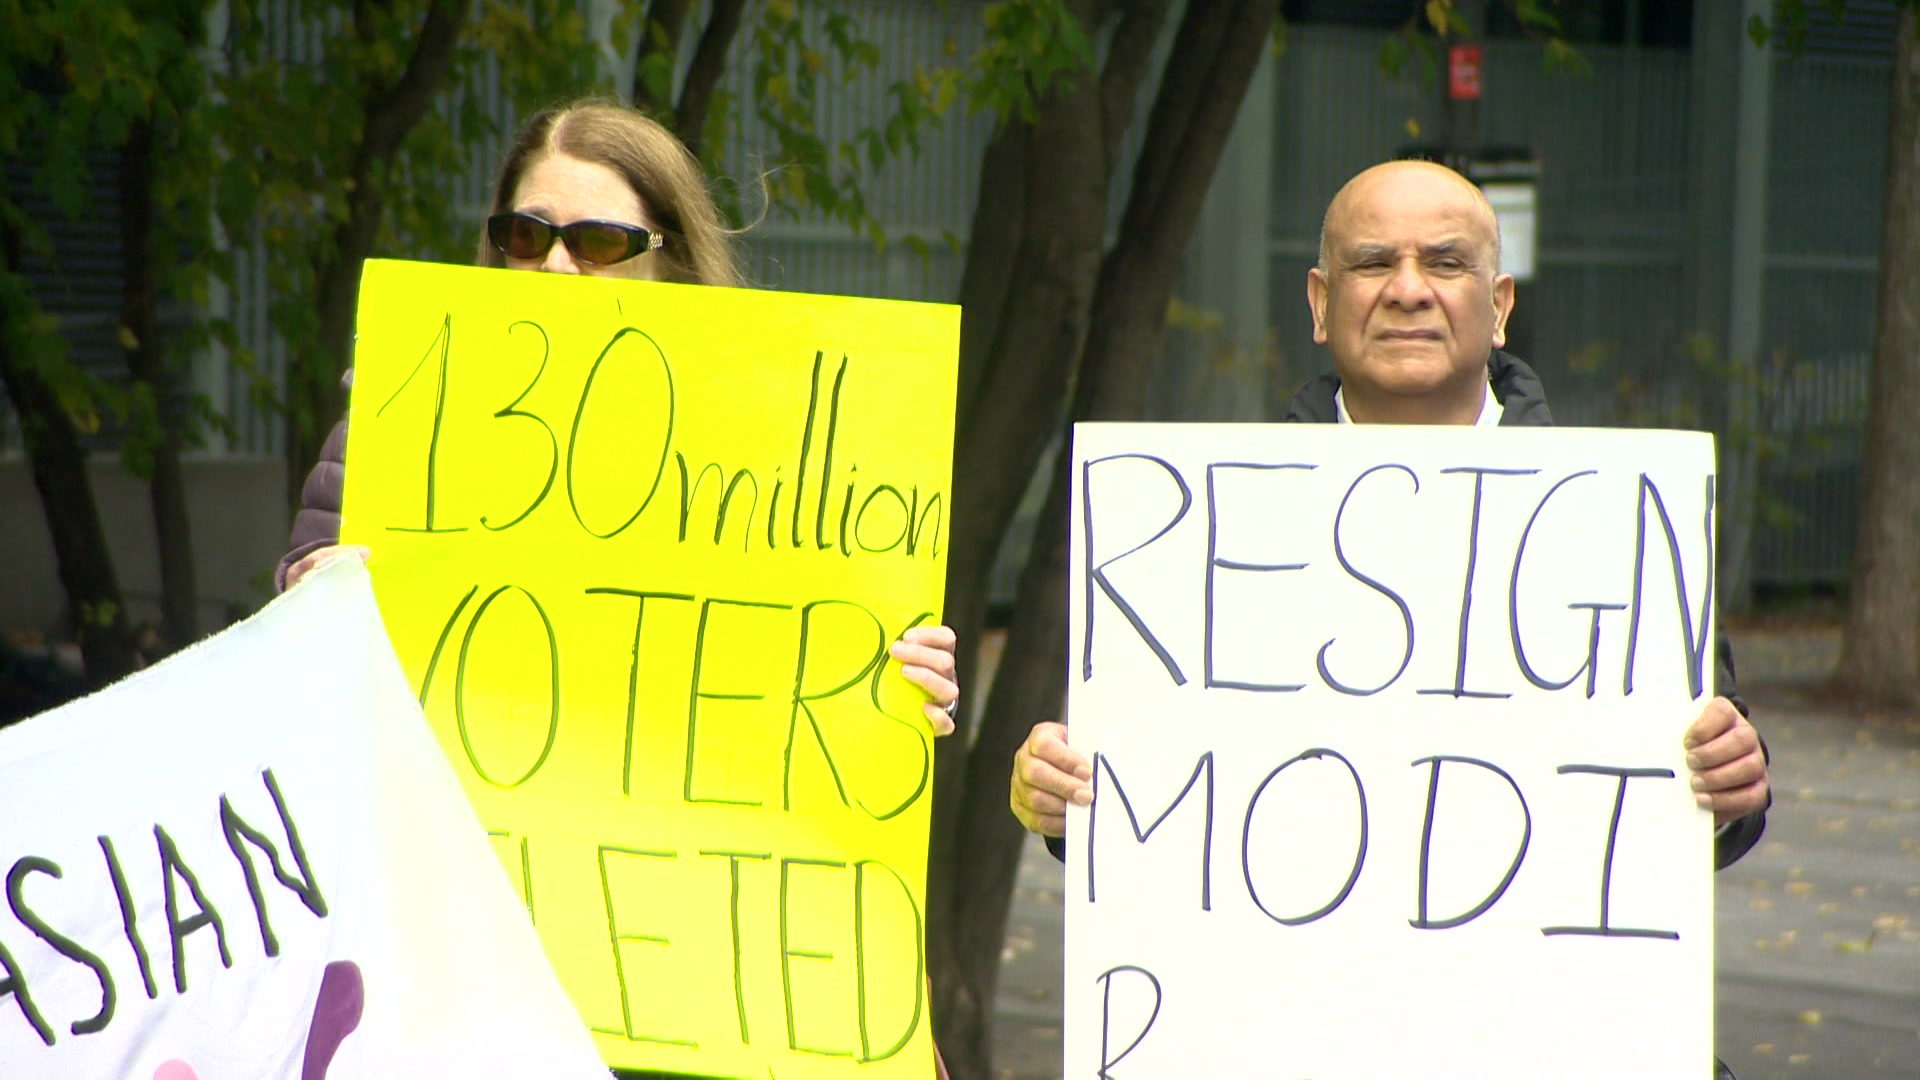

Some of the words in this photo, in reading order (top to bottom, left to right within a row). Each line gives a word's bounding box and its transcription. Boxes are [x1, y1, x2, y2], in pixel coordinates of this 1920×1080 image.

[376, 313, 675, 539] 130
[675, 349, 942, 561] million
[1082, 453, 1715, 701] RESIGN
[486, 831, 924, 1063] ETED
[1088, 747, 1680, 941] MODI
